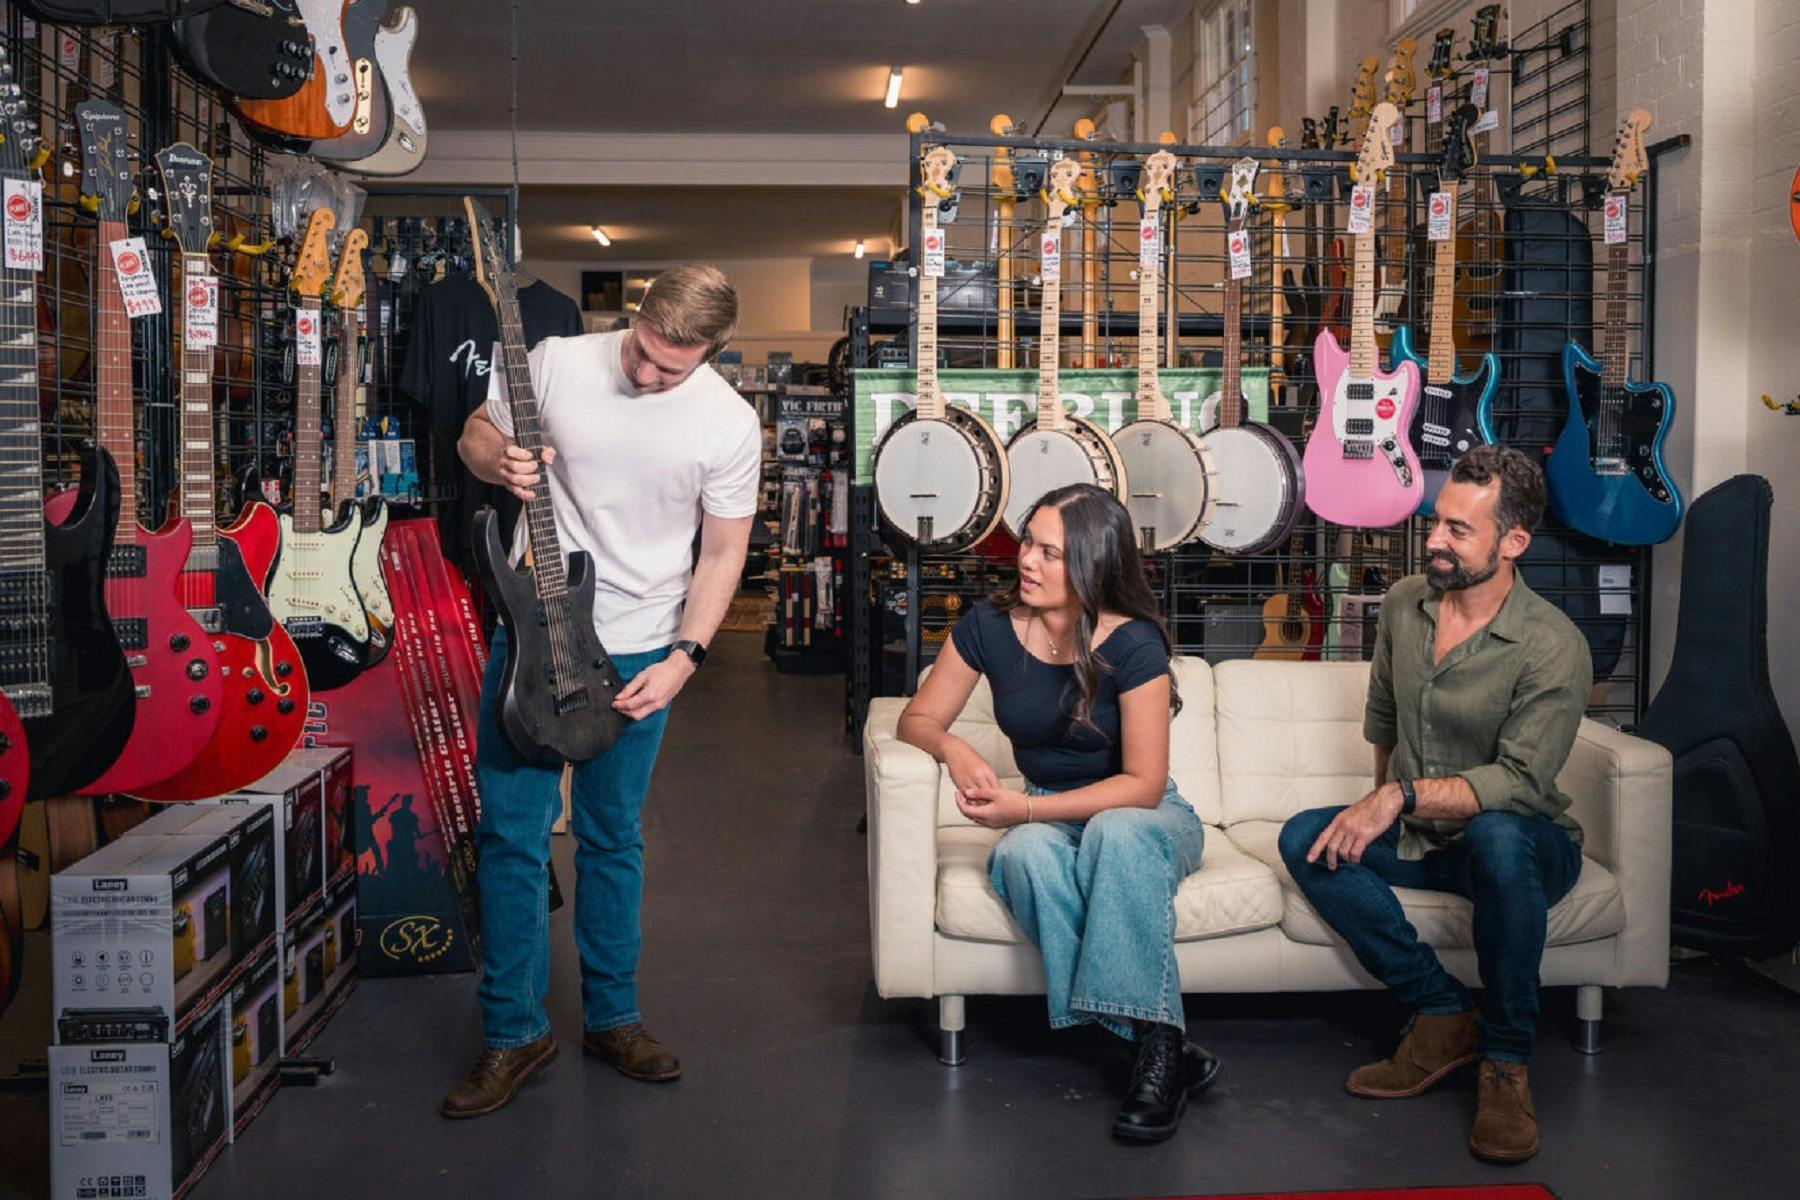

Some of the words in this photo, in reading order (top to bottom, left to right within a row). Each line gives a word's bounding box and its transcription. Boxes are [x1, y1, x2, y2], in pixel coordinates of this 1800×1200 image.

[428, 697, 449, 755] Guitar
[448, 693, 467, 749] Guitar
[444, 760, 468, 832] Electric
[95, 880, 126, 890] Laney
[391, 921, 441, 954] SX
[79, 1066, 109, 1074] ELECTRIC
[110, 1065, 133, 1073] GUITAR
[133, 1064, 156, 1072] COMBO
[93, 1051, 125, 1061] Laney
